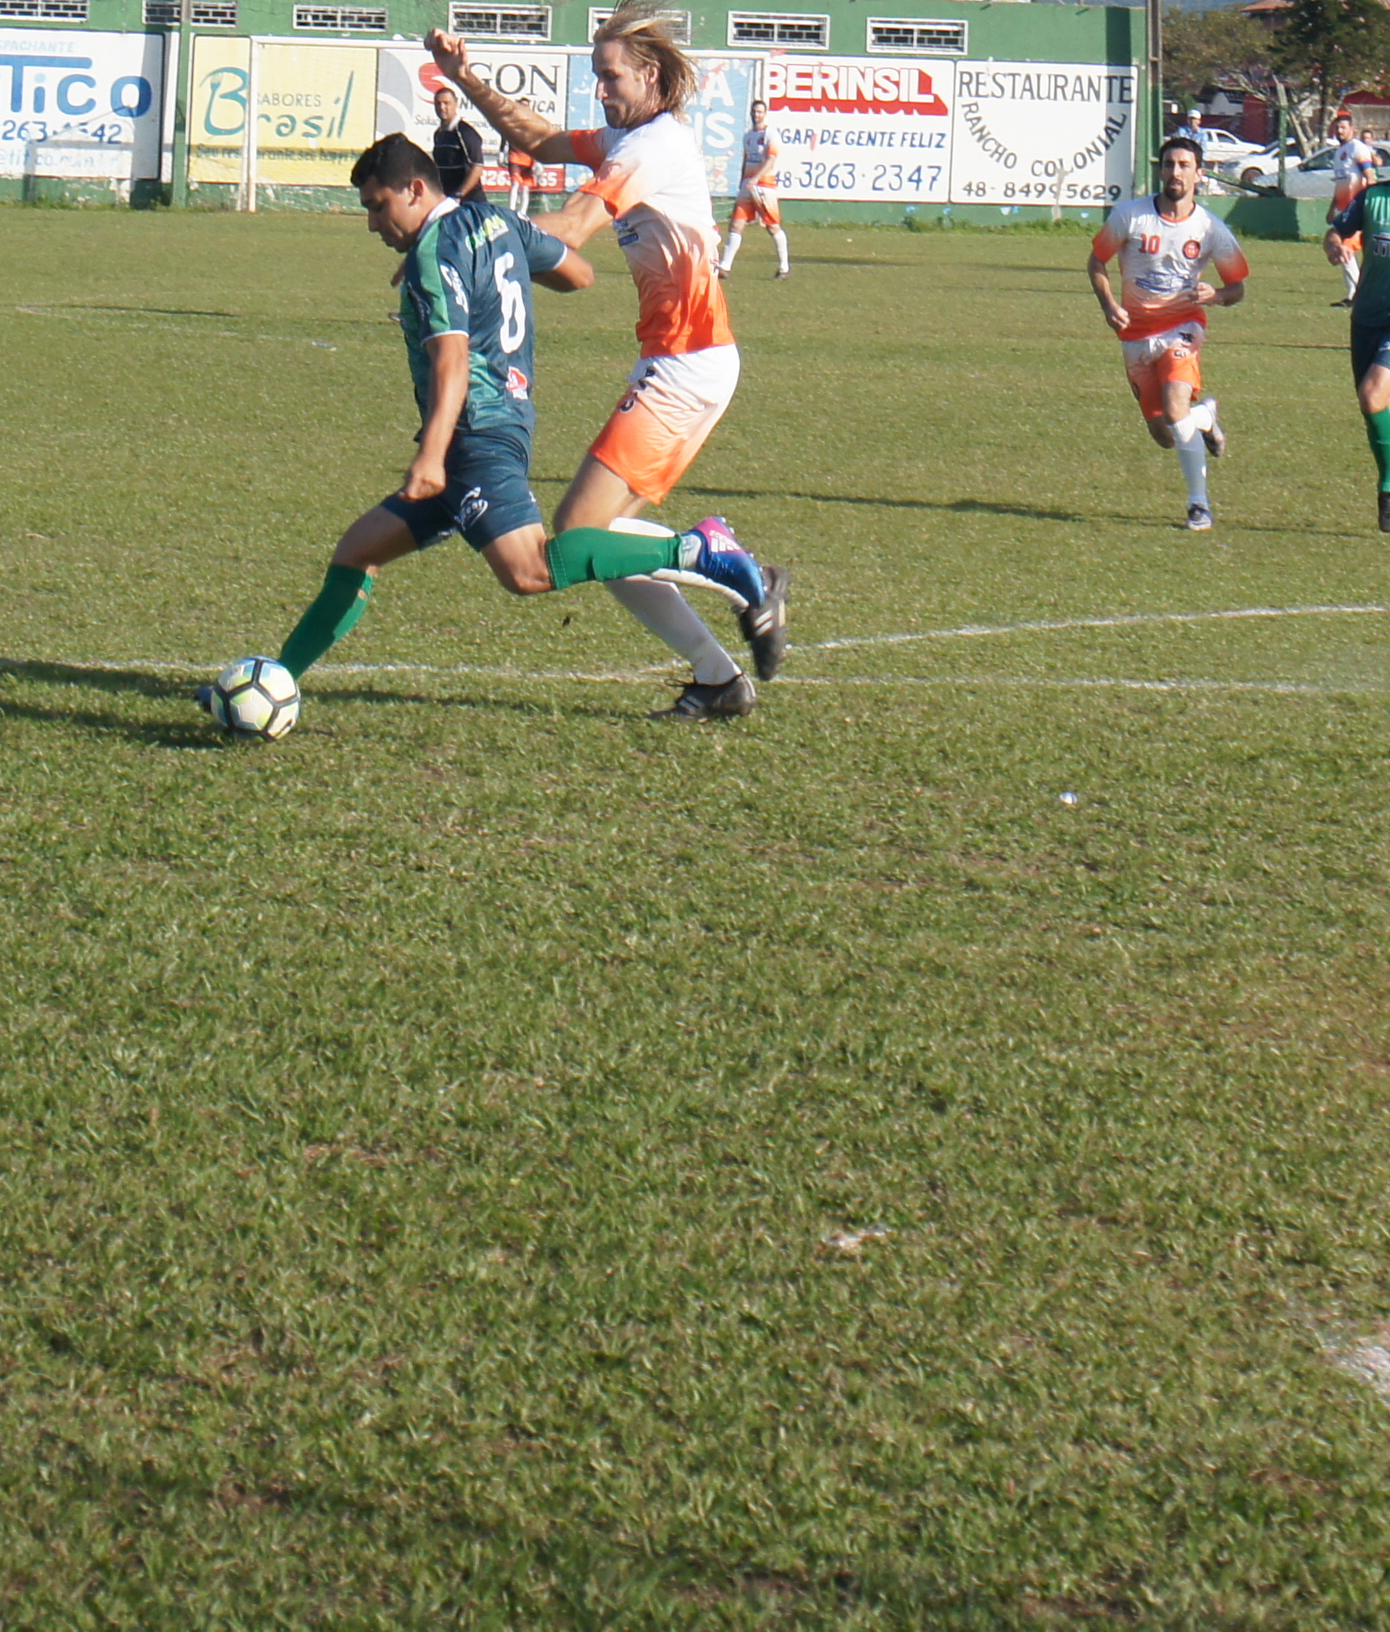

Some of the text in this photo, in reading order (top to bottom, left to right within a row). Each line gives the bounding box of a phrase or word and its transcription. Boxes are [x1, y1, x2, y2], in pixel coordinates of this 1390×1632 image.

[957, 71, 1135, 104] RESTAURANTE
[819, 130, 842, 145] DE
[845, 131, 899, 147] GENTE
[900, 132, 947, 149] FELIZ
[961, 101, 1128, 178] RANCHO COLONIAL
[1139, 233, 1161, 255] 10
[494, 252, 527, 354] 6
